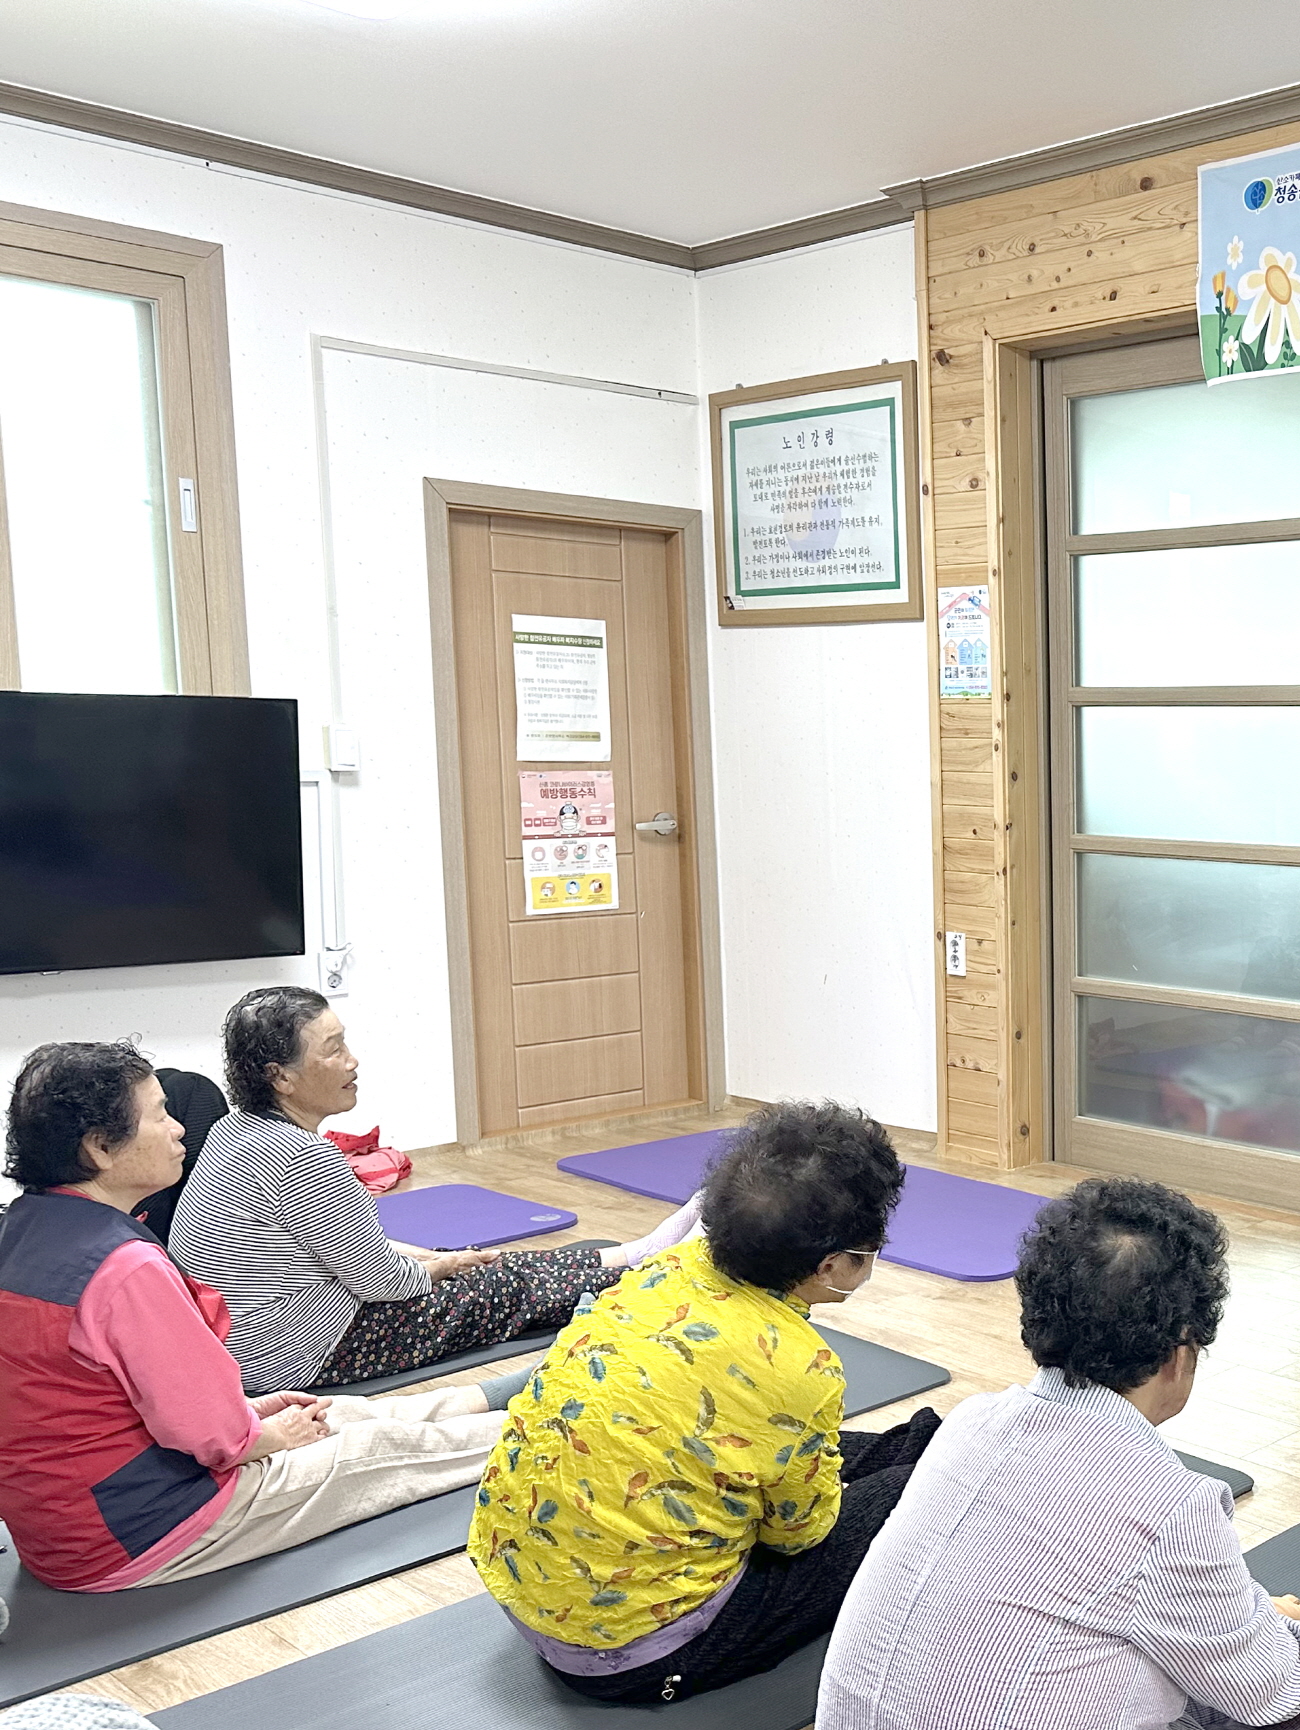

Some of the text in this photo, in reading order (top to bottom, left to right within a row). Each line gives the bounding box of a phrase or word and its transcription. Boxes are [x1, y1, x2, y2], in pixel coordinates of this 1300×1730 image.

[1276, 172, 1300, 185] 산소카페
[746, 467, 761, 477] 우리는
[763, 463, 778, 475] 사회의
[780, 460, 807, 473] 어른으로서
[765, 477, 782, 489] 지니는
[822, 471, 838, 482] 우리가
[751, 526, 766, 536] 우리는
[752, 554, 767, 565] 우리는
[792, 550, 814, 561] 사회에서
[839, 547, 856, 558] 노인이
[752, 569, 768, 581] 우리는
[540, 788, 596, 799] 예방행동수칙
